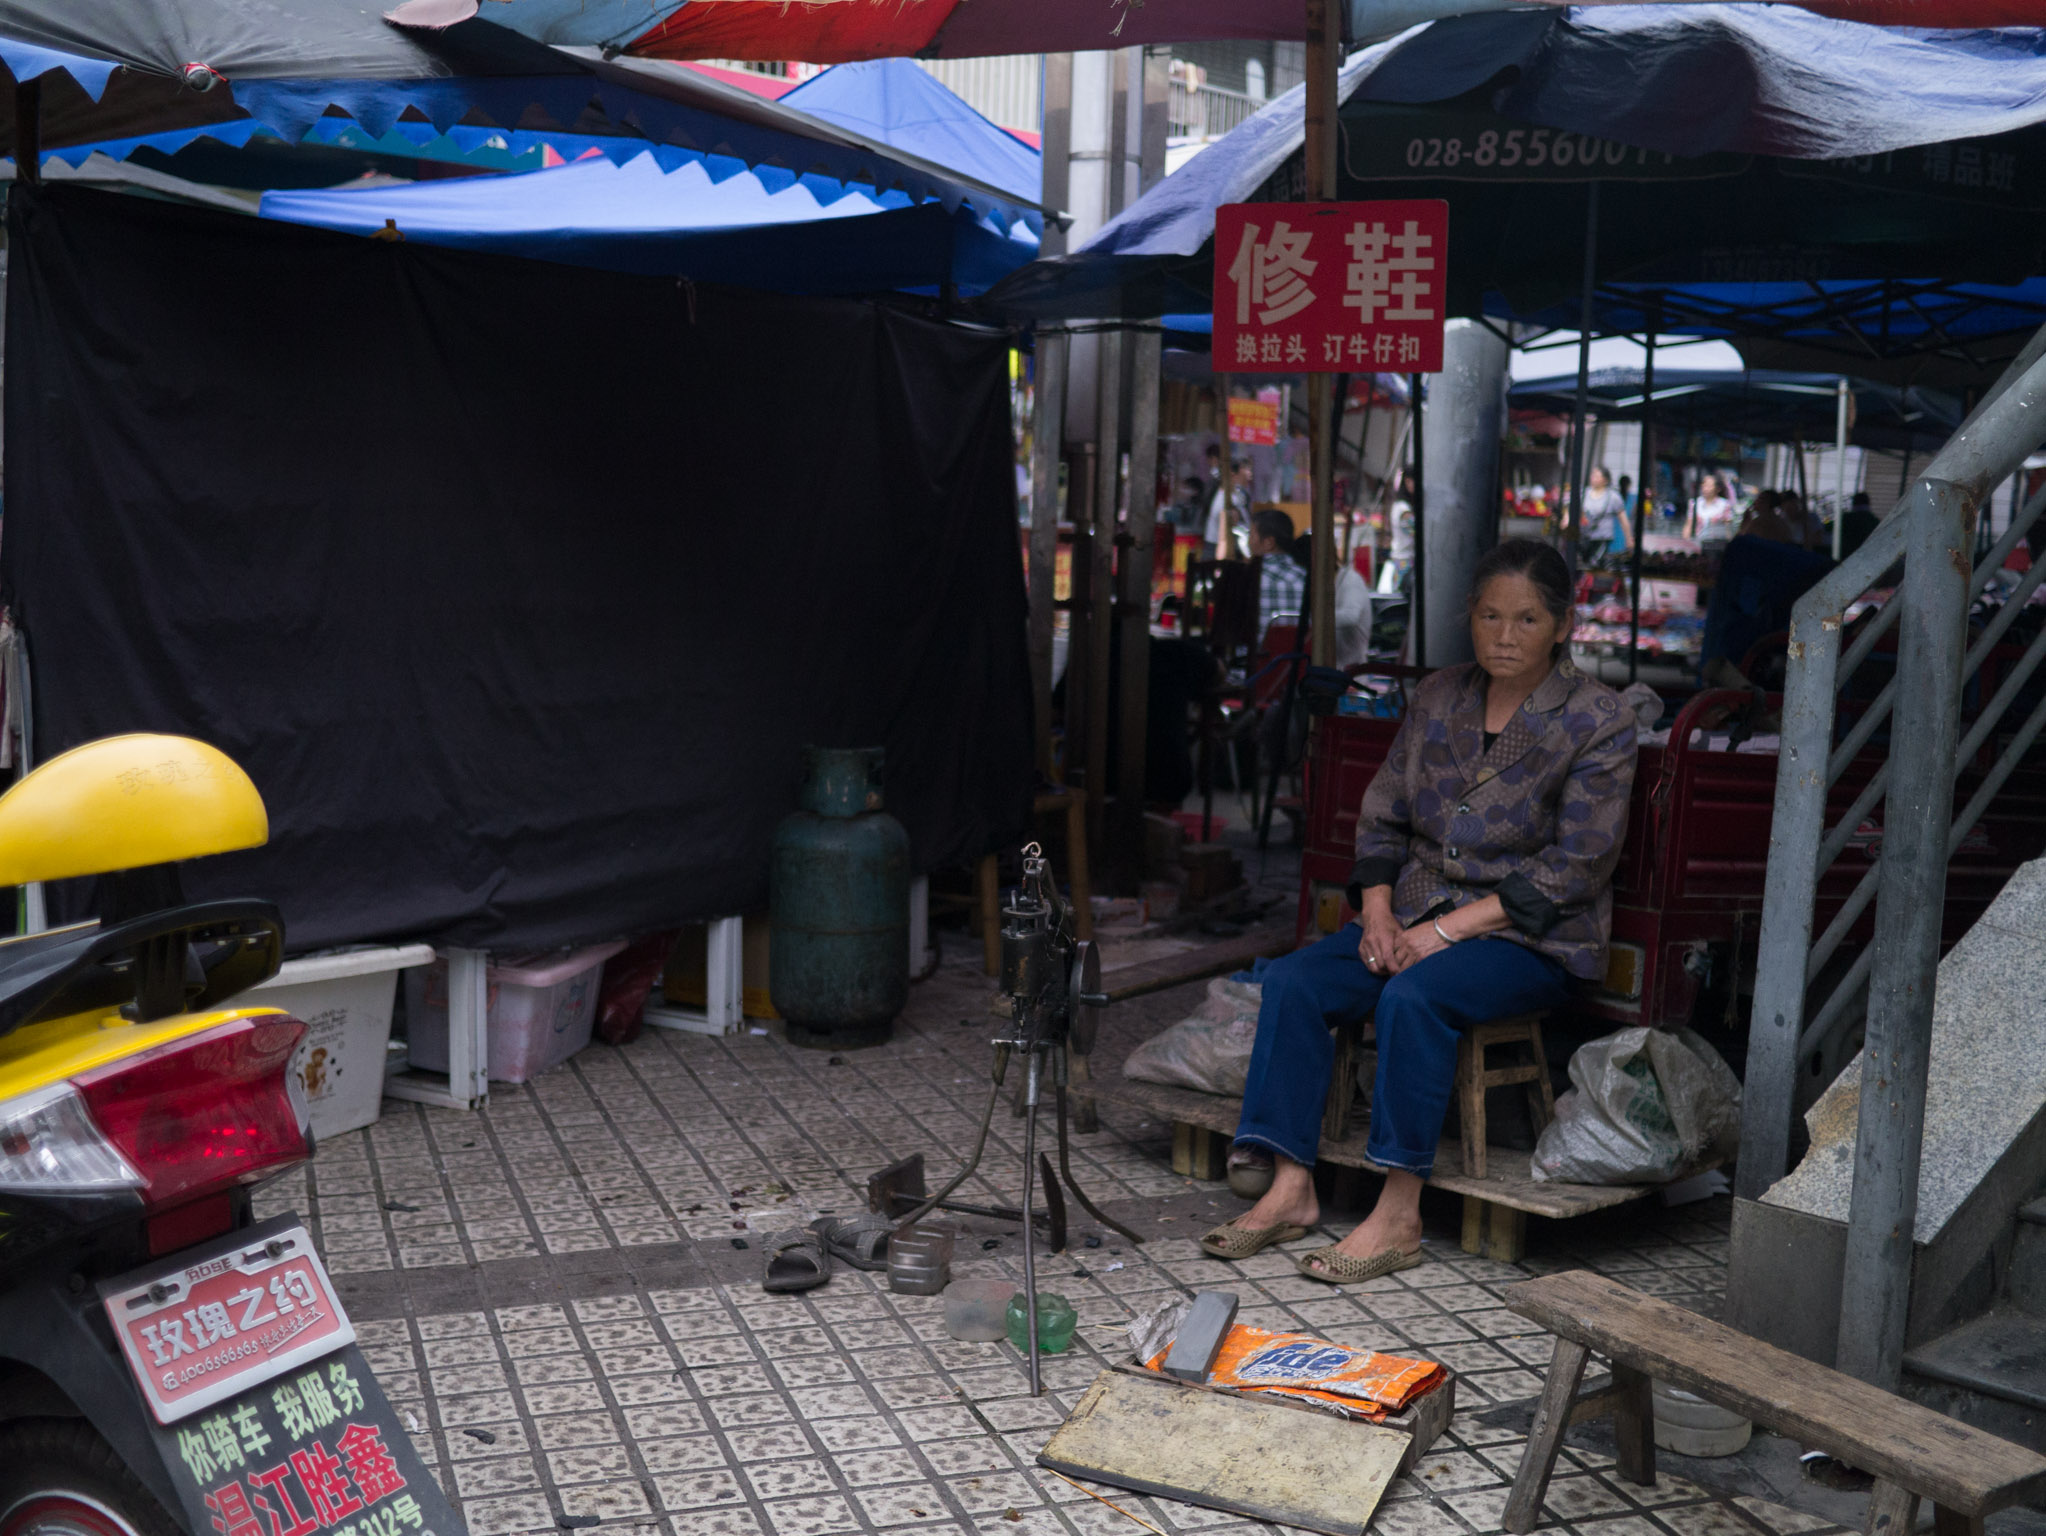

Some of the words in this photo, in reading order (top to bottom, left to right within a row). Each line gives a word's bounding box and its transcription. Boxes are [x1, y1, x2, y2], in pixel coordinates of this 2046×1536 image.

[1227, 220, 1435, 326] 修鞋
[1236, 333, 1307, 364] 换拉头
[1323, 333, 1420, 364] 订牛仔扣
[140, 1269, 318, 1368] 玫瑰之约
[185, 1258, 233, 1282] ROSE
[177, 1403, 272, 1486] 你骑车
[272, 1362, 365, 1442] 我服务
[204, 1422, 407, 1536] 温江胜鑫
